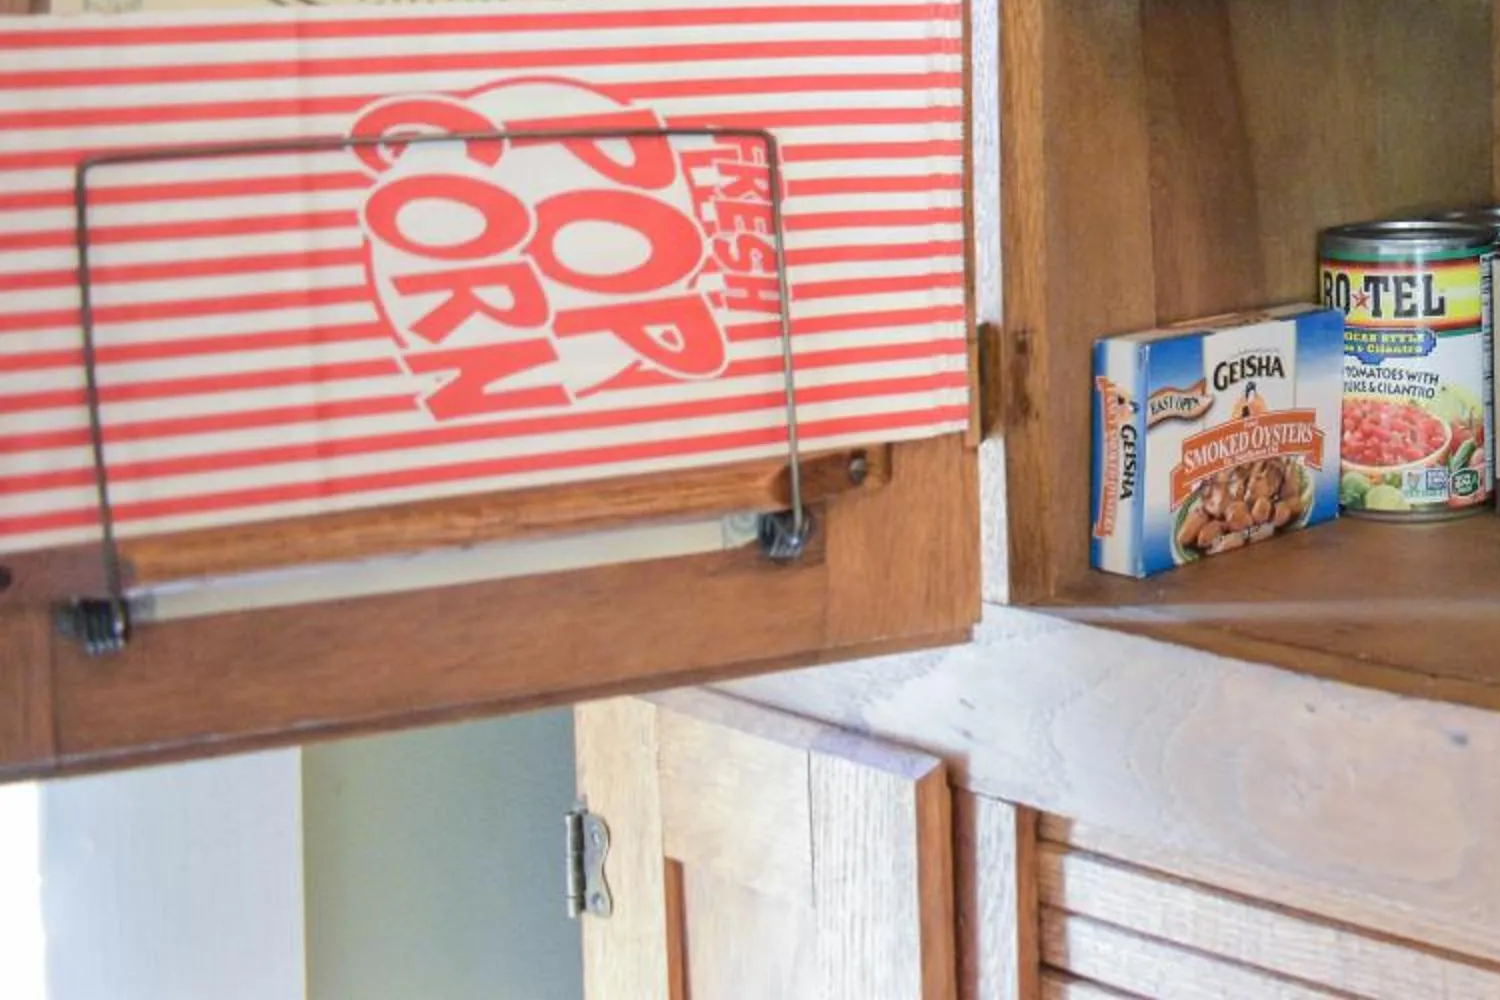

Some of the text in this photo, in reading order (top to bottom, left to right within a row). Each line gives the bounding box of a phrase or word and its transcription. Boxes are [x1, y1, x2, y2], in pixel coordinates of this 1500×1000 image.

[350, 98, 573, 422] CORN
[1213, 354, 1285, 392] GEISHA
[1344, 367, 1440, 386] TOMATOES WITH
[1377, 383, 1435, 398] CILANTRO
[1119, 423, 1138, 500] GEISHA
[1184, 420, 1313, 473] SMOKED OYSTERS
